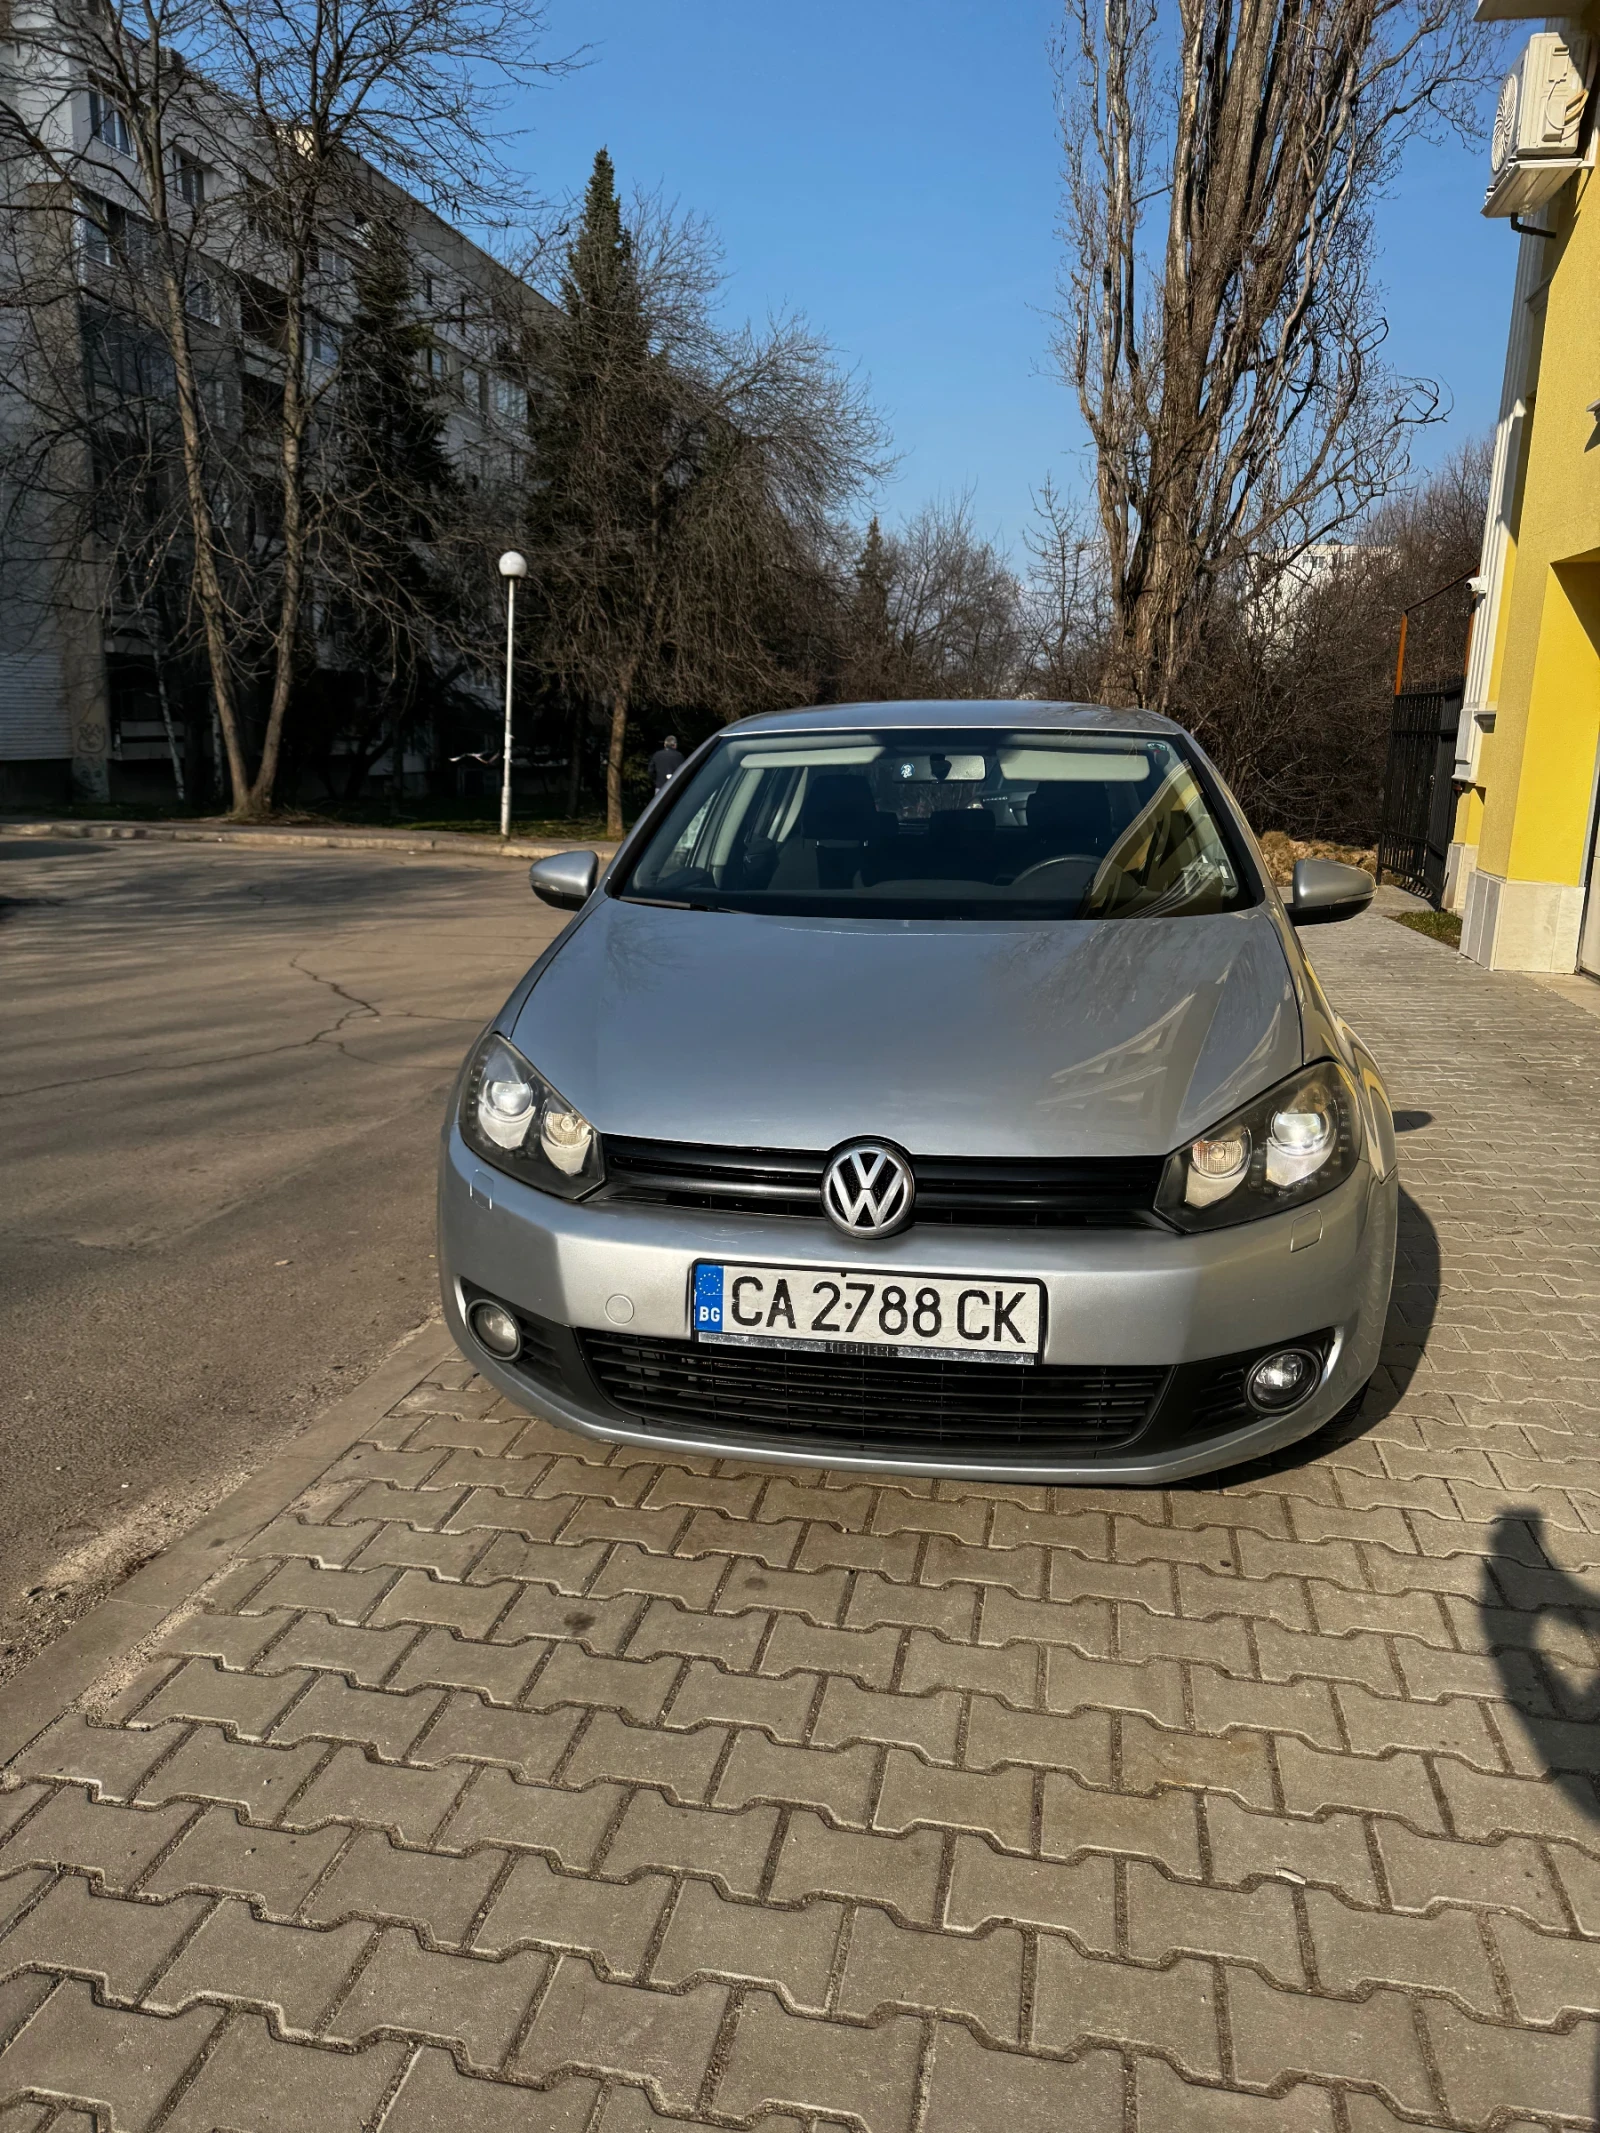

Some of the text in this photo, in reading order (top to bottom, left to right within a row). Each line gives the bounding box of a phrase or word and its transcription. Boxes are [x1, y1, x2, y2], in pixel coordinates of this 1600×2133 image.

[699, 1305, 720, 1322] BG
[731, 1275, 1026, 1343] CA 2788 CK
